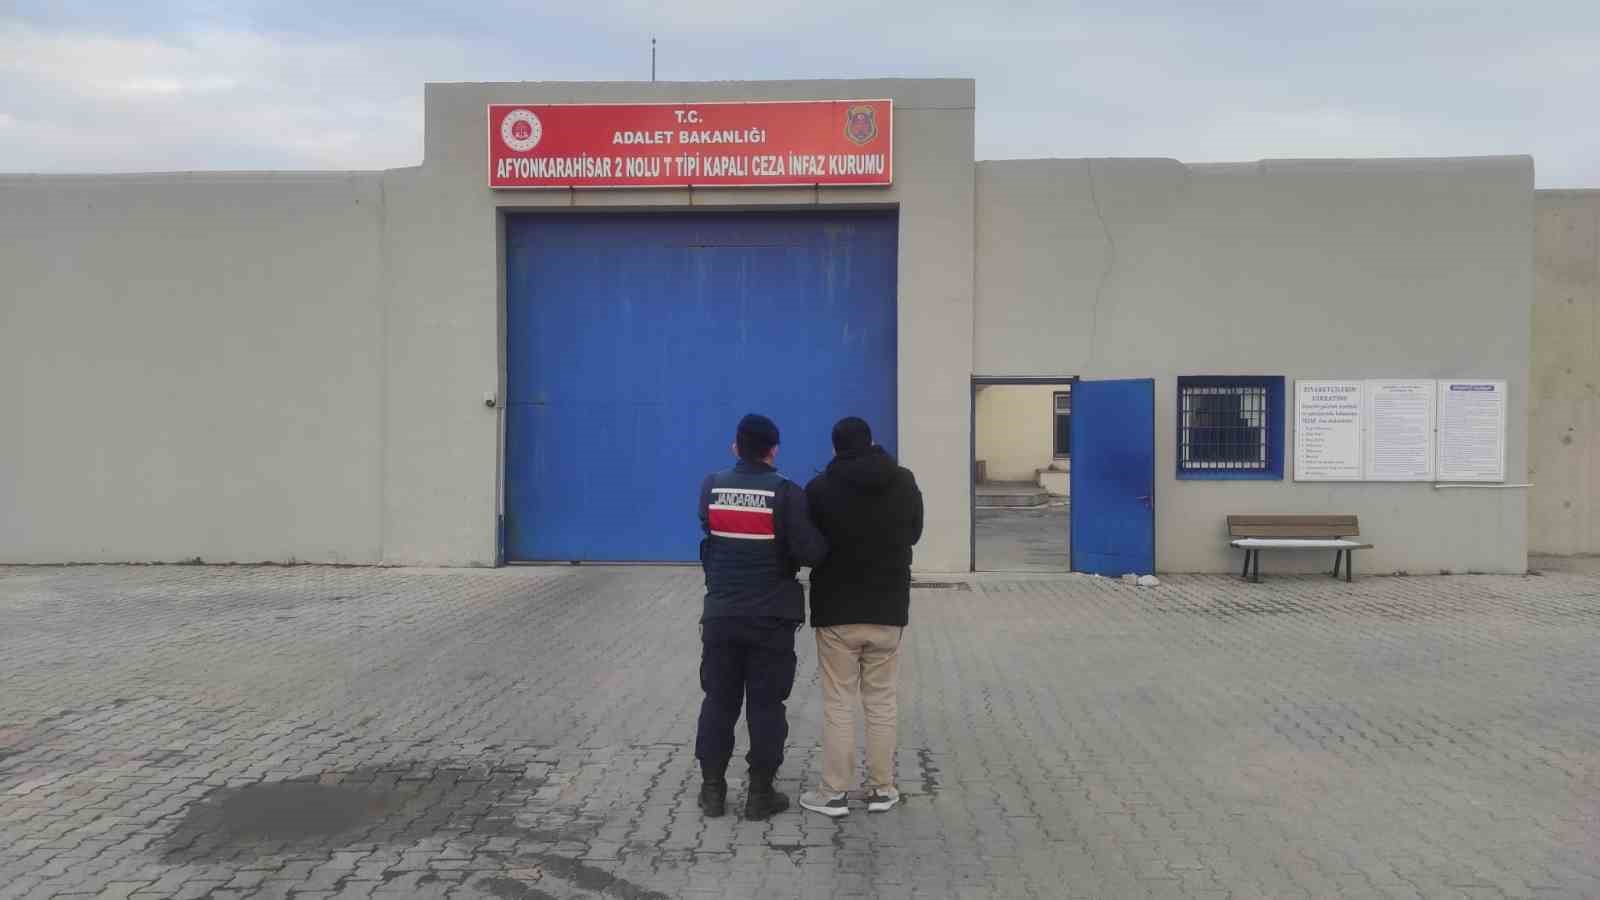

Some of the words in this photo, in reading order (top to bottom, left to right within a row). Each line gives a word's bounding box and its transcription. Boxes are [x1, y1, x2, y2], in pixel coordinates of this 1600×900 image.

[674, 110, 703, 124] T.C.
[612, 131, 674, 145] ADALET
[679, 127, 767, 145] BAKANLIĞI
[496, 152, 612, 178] AFYONKARAHİSAR
[615, 158, 623, 178] 2
[626, 156, 661, 178] NOLU
[663, 157, 673, 177] T
[675, 151, 699, 177] TİPİ
[703, 155, 749, 177] KAPALI
[752, 154, 786, 176] CEZA
[789, 151, 826, 176] İNFAZ
[828, 153, 886, 176] KURUMU
[715, 493, 767, 507] JANDARMA
